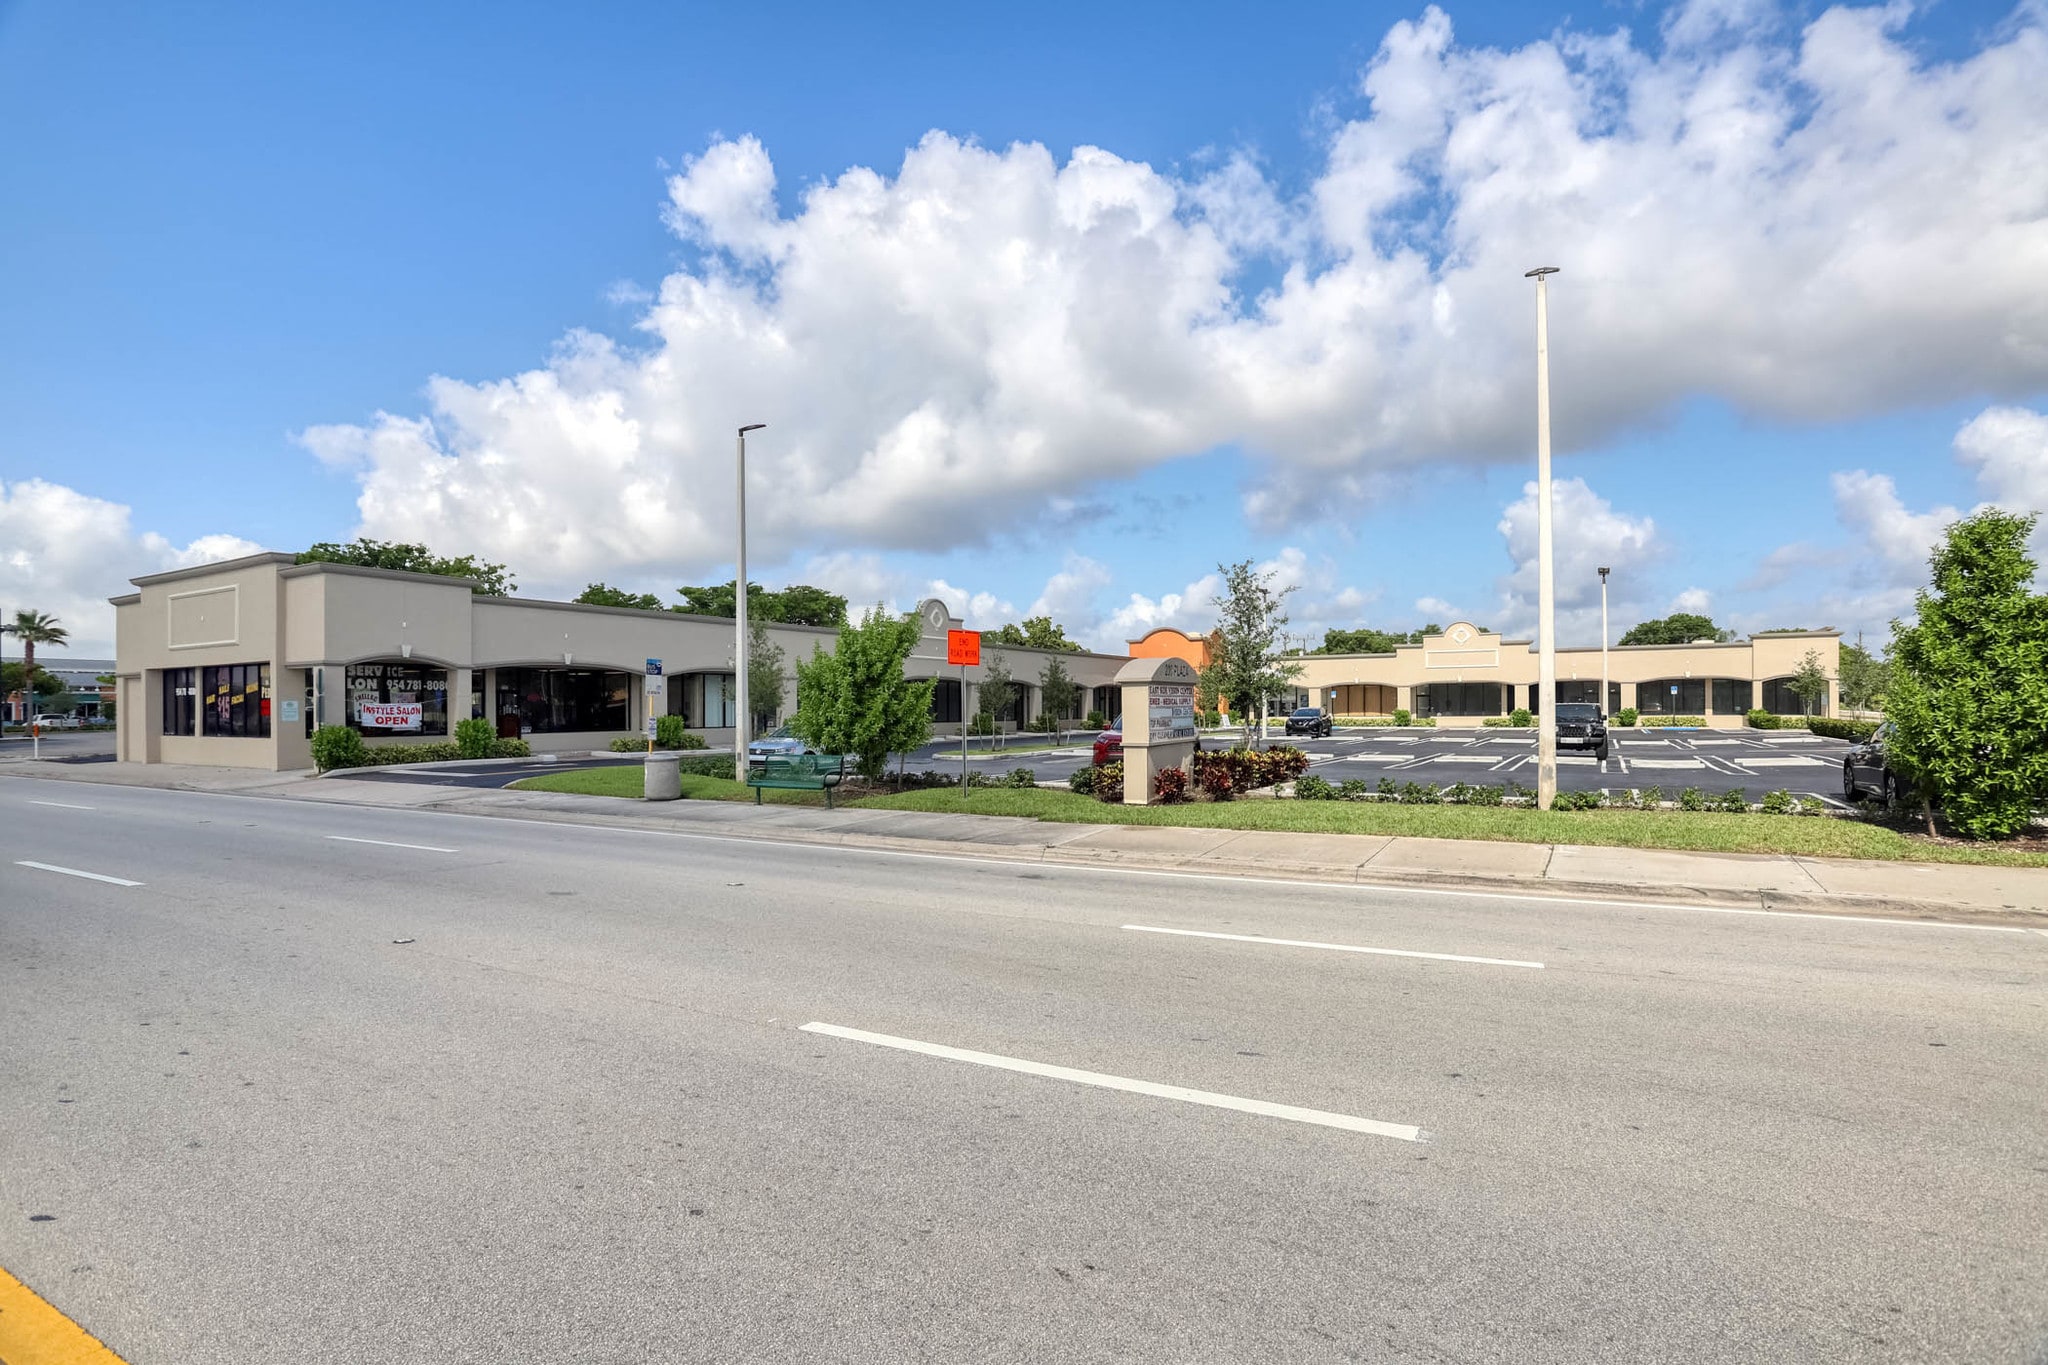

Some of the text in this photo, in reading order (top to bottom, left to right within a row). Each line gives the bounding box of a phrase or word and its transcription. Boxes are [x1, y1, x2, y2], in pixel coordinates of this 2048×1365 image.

[347, 678, 378, 690] LON
[386, 679, 404, 690] 954
[363, 704, 421, 716] INSTYLE SALON
[375, 716, 408, 725] OPEN
